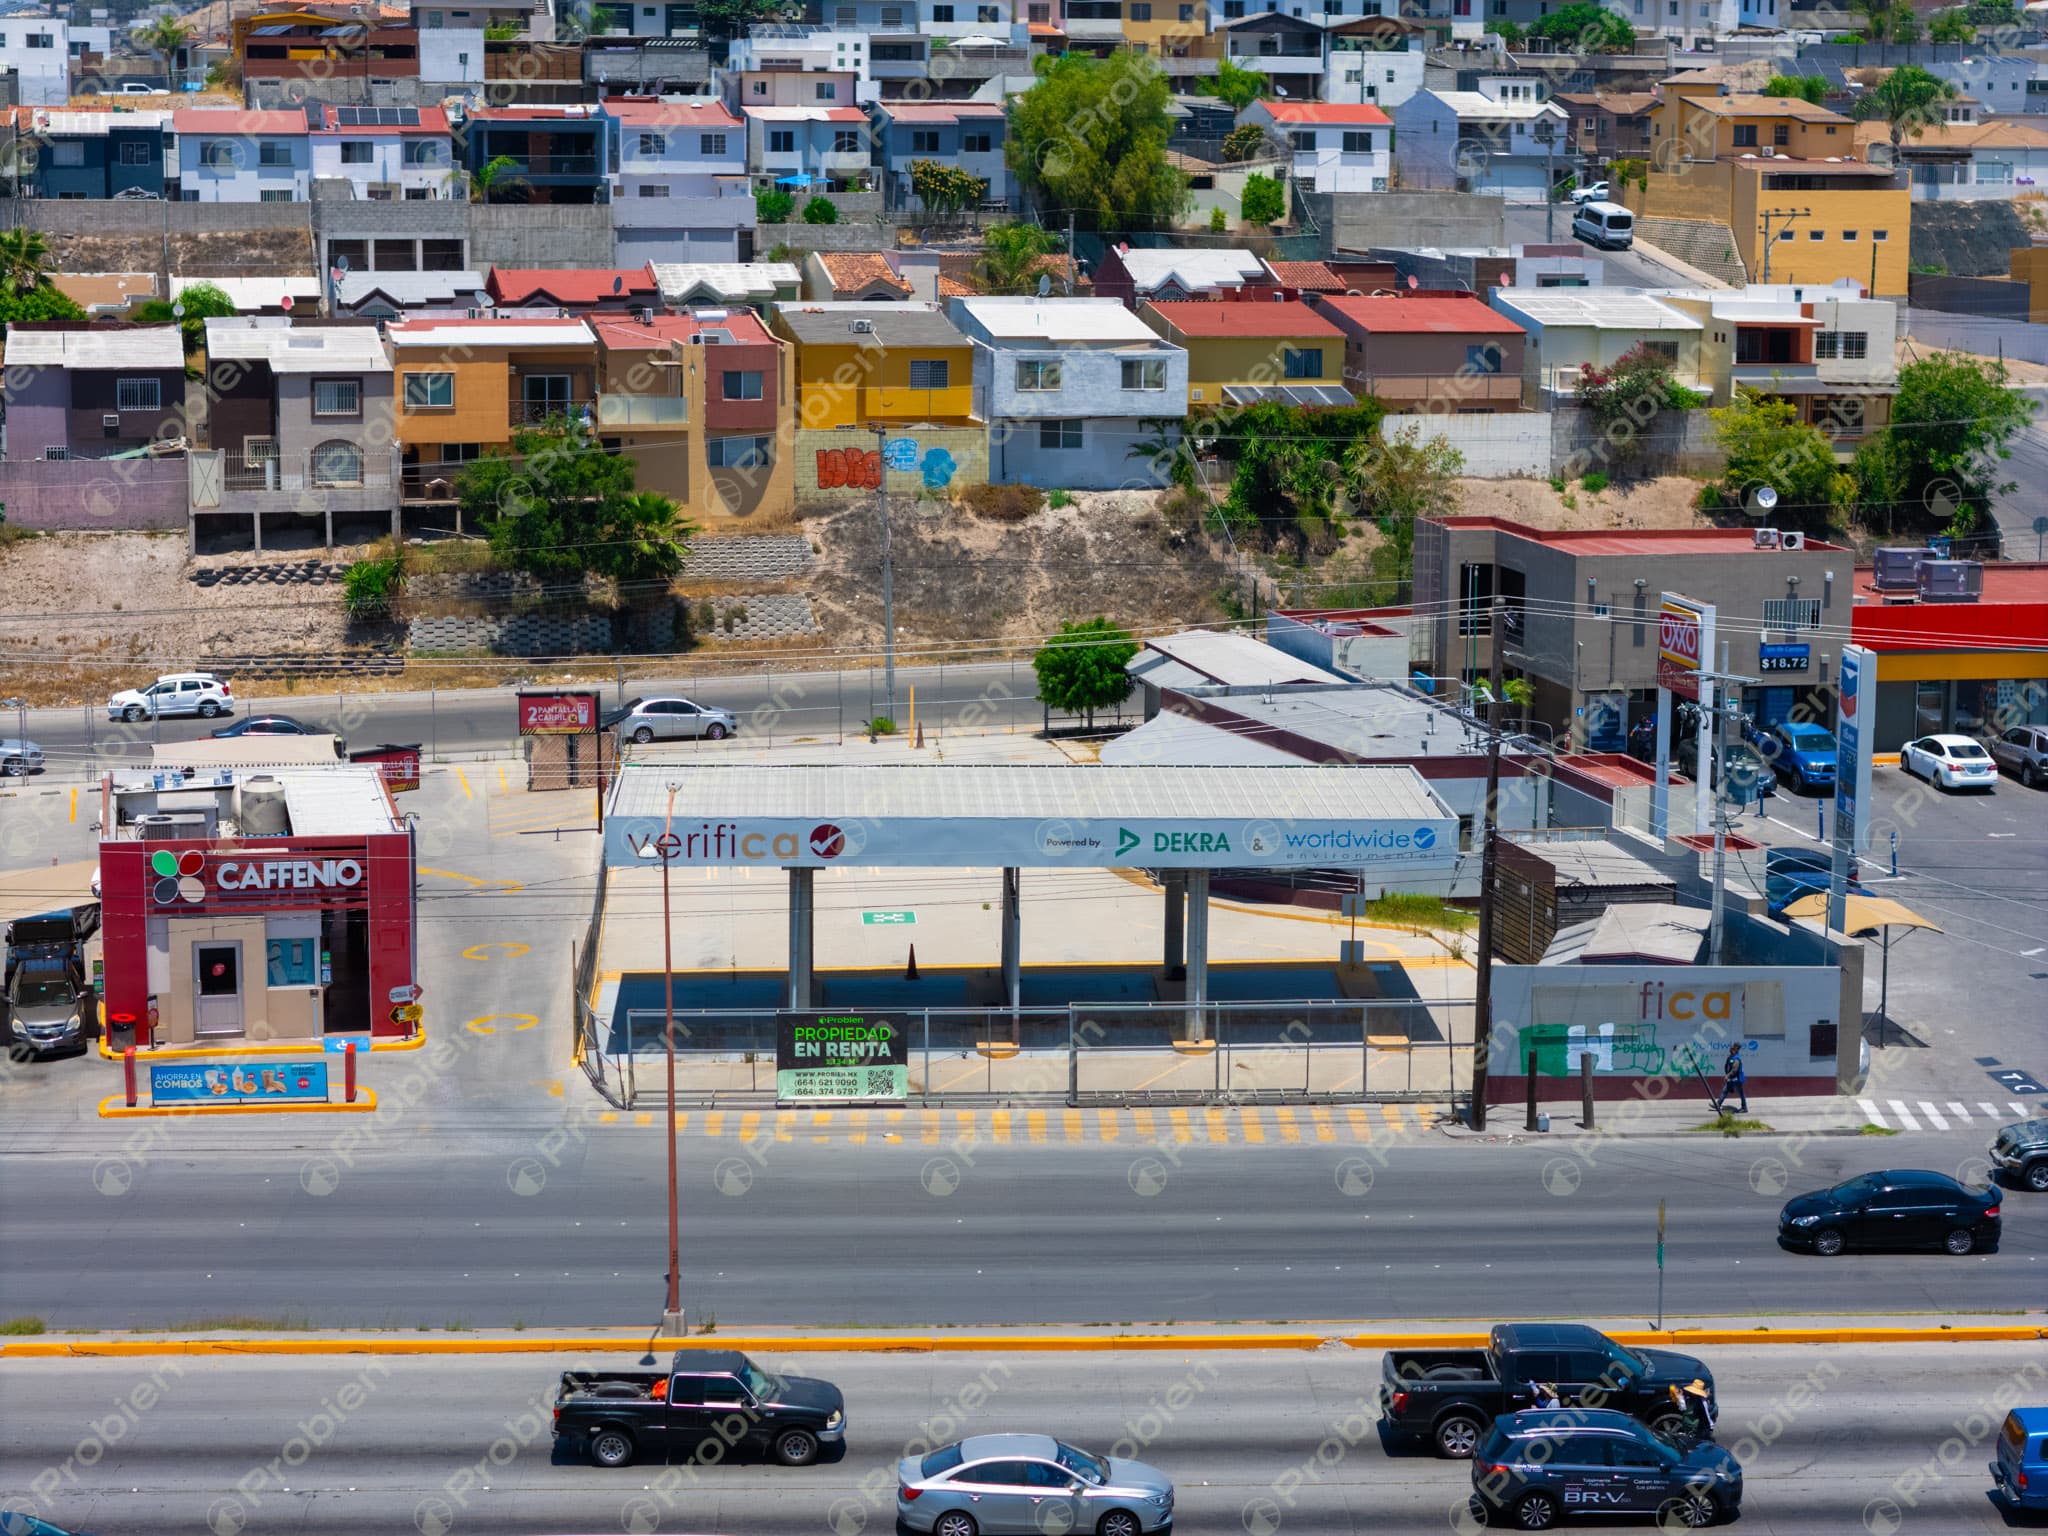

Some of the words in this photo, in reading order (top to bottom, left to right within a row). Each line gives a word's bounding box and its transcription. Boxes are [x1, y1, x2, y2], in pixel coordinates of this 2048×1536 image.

[1661, 616, 1696, 653] OXXO
[1761, 657, 1808, 669] $18.72
[528, 707, 538, 721] 2
[538, 706, 577, 714] PANTALLA
[627, 823, 799, 858] verifica
[1046, 837, 1086, 847] Powered
[1089, 837, 1101, 848] by
[1154, 831, 1231, 852] DEKRA
[1286, 829, 1410, 848] worldwide
[216, 859, 362, 890] CAFFENIO
[794, 1027, 891, 1041] PROPIEDAD
[794, 1042, 820, 1057] EN
[826, 1042, 891, 1057] RENTA
[156, 1073, 191, 1081] AHORRA
[155, 1080, 203, 1089] COMBOS
[794, 1087, 816, 1095] (664)
[1564, 1492, 1625, 1503] BR-V
